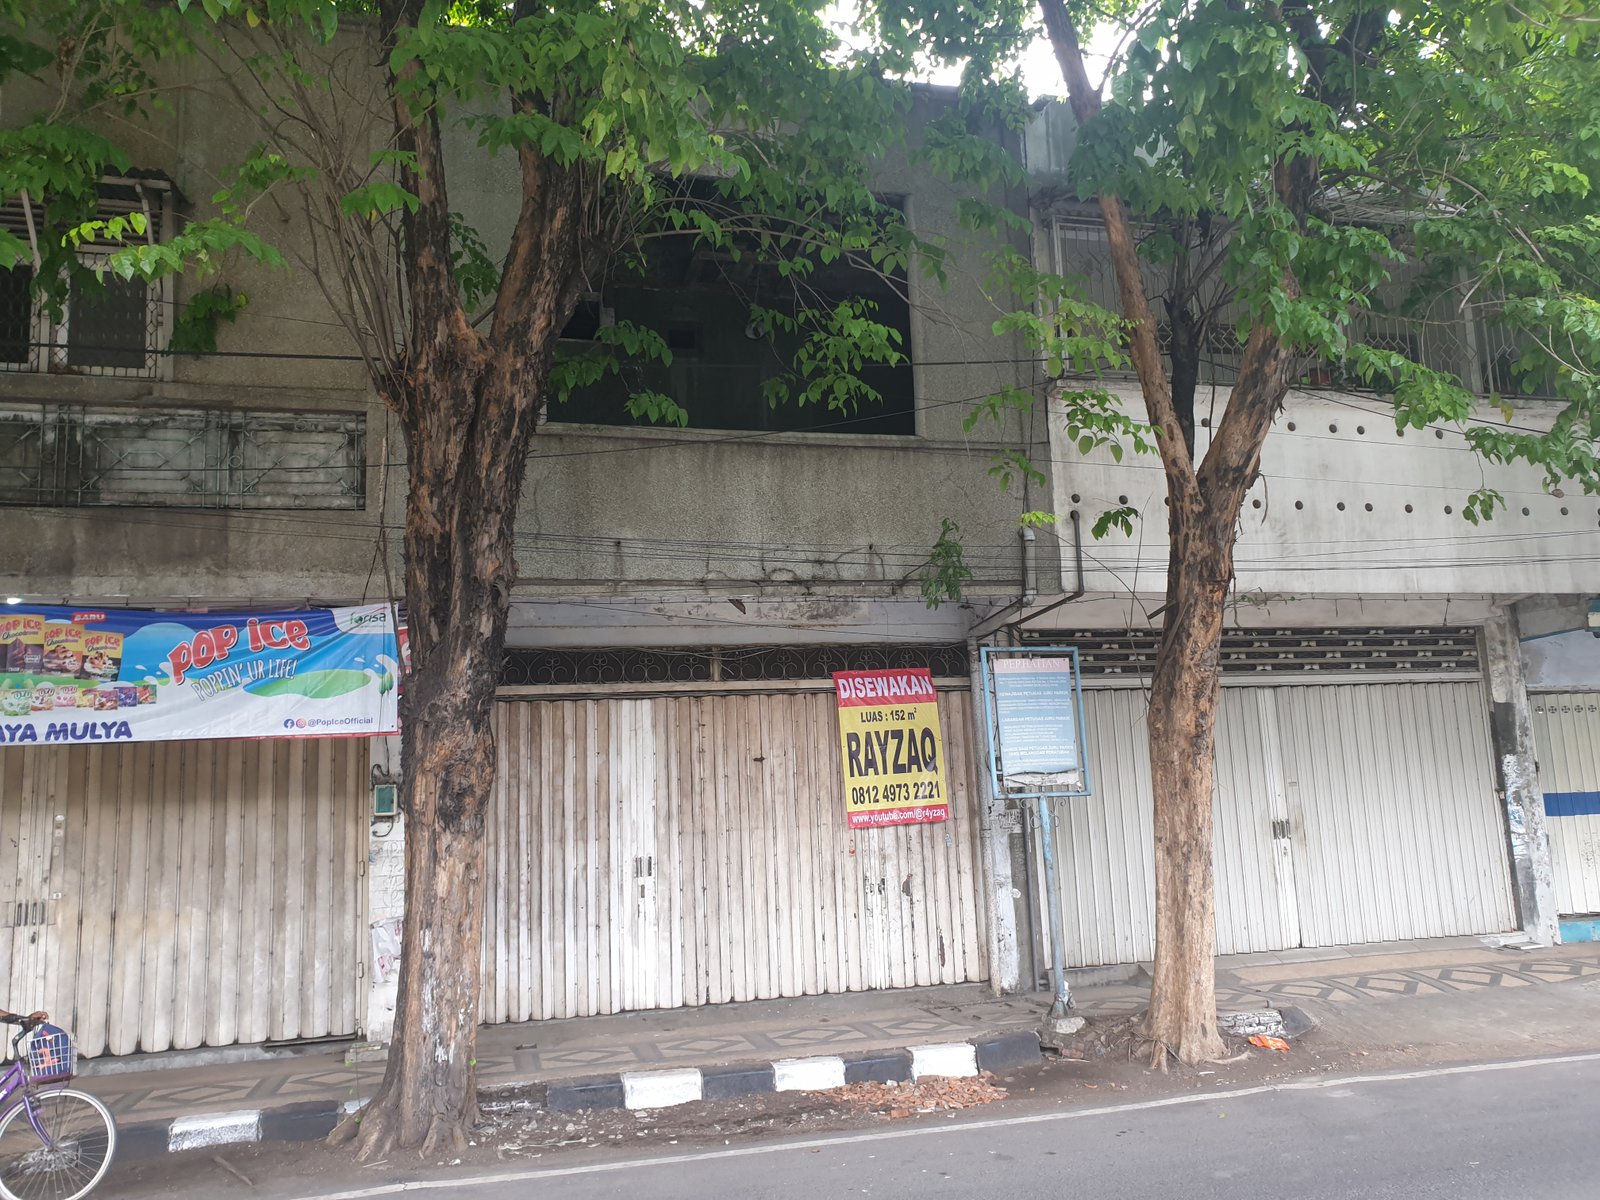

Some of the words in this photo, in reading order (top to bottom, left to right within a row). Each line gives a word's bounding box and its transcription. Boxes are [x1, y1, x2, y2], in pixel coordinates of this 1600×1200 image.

[167, 624, 239, 686] POP
[191, 662, 243, 701] POPPIN'
[247, 660, 265, 681] UR
[268, 658, 298, 680] LIFE!
[838, 675, 933, 699] DISEWAKAN
[308, 717, 373, 727] @PopIceOfficial
[861, 711, 883, 723] LUAS
[890, 709, 906, 721] 152
[45, 721, 133, 741] MULYA
[847, 727, 938, 777] RAYZAQ
[852, 785, 879, 805] 0812
[882, 783, 910, 802] 4973
[913, 780, 940, 800] 2221
